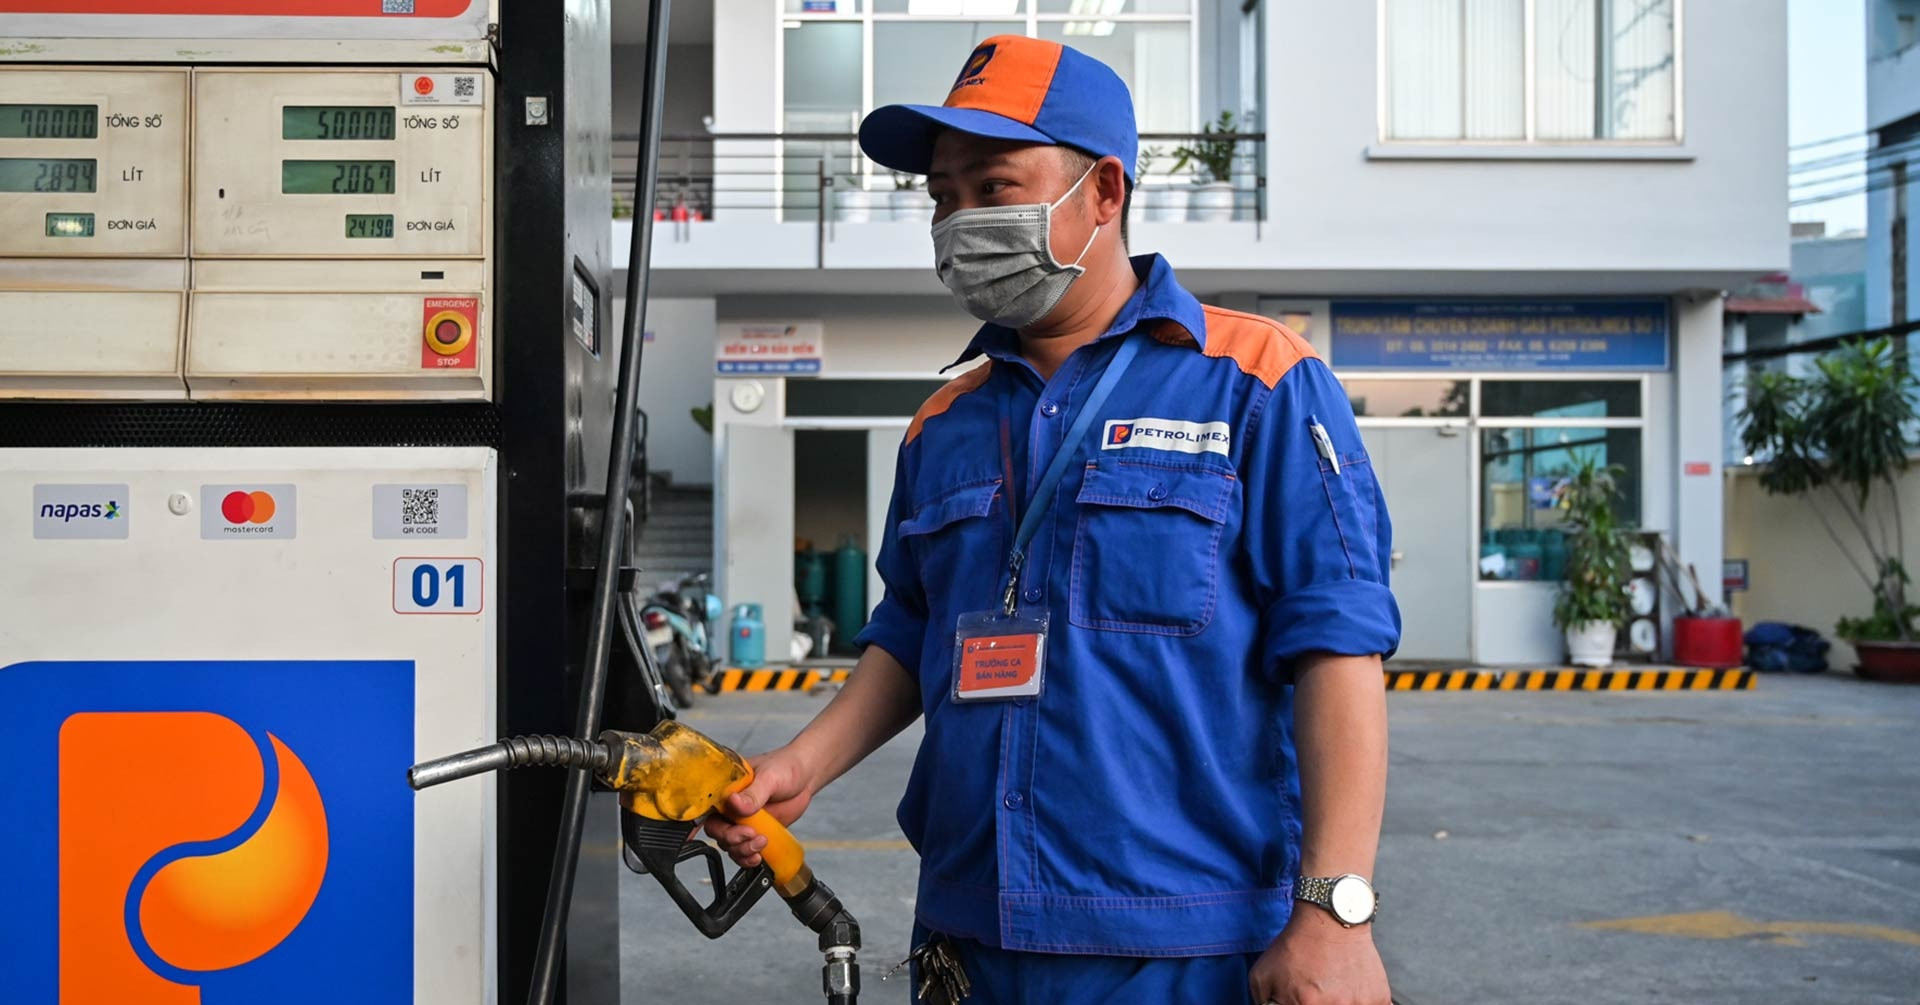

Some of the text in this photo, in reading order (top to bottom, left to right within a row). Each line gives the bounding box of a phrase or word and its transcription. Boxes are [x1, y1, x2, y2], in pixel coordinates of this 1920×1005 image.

[21, 109, 95, 137] 70000
[105, 112, 163, 128] TỔNG SỐ
[318, 110, 393, 139] 50000
[403, 114, 460, 129] TỔNG SỐ
[122, 166, 144, 182] LÍT
[421, 167, 442, 183] LÍT
[135, 217, 157, 230] GIÁ
[349, 218, 393, 238] 24190
[434, 218, 455, 231] GIÁ
[426, 300, 476, 309] EMERGENCY
[437, 358, 461, 367] STOP
[1134, 427, 1229, 446] PETROLIMEX
[40, 502, 102, 522] napas
[412, 563, 464, 607] 01
